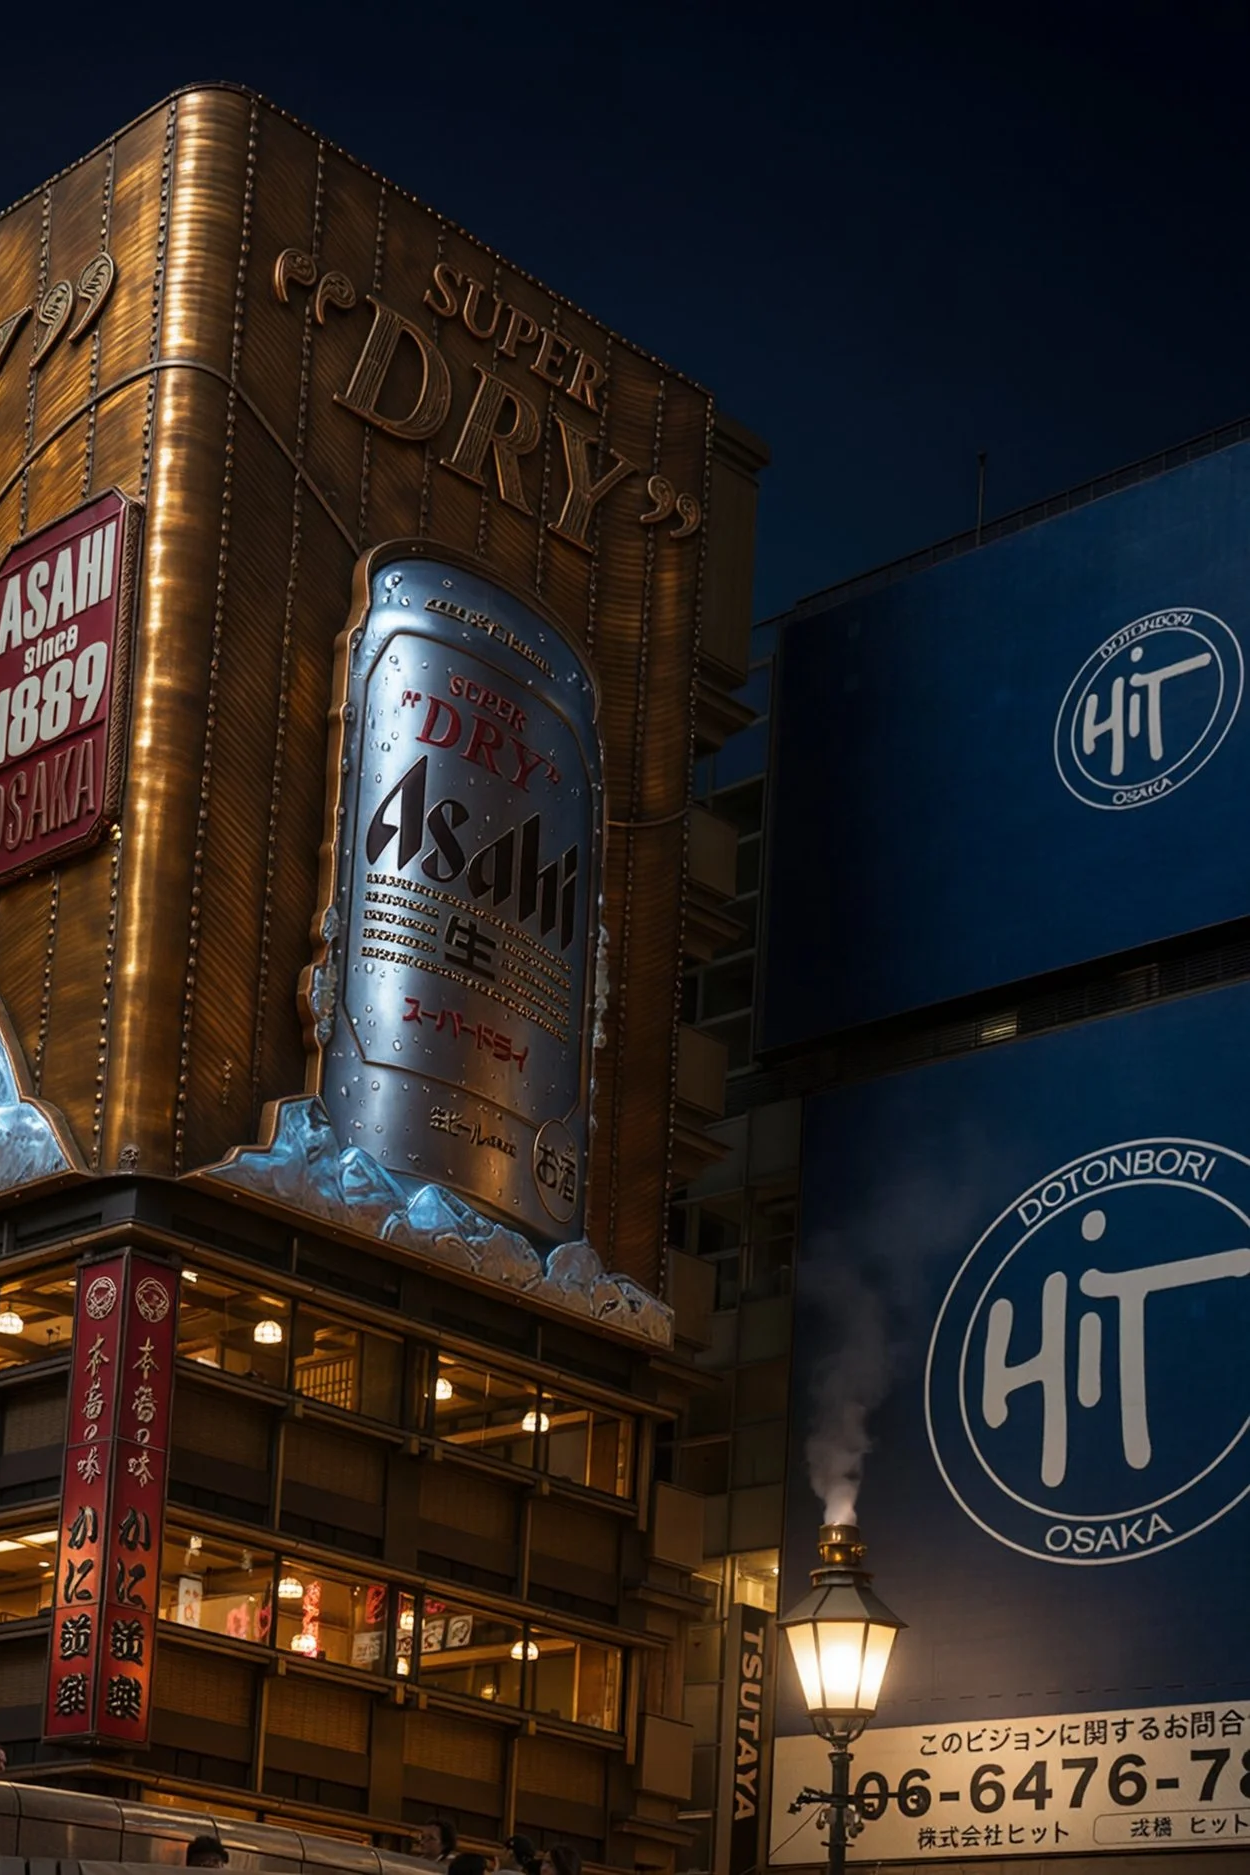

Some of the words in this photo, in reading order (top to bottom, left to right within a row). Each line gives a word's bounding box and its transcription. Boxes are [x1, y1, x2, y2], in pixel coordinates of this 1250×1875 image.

[424, 262, 609, 414] SUPER
[450, 674, 529, 733] SUPER
[366, 755, 578, 951] Asahi
[1017, 1148, 1216, 1228] DOTONBORI
[1045, 1513, 1174, 1554] OSAKA
[734, 1627, 765, 1821] TSUTAYA
[920, 1709, 1250, 1756] このビジョンに関するお問合
[854, 1748, 1250, 1821] 06-6476-7
[918, 1821, 1069, 1850] 株式会社ヒット
[1191, 1813, 1250, 1835] ヒット
